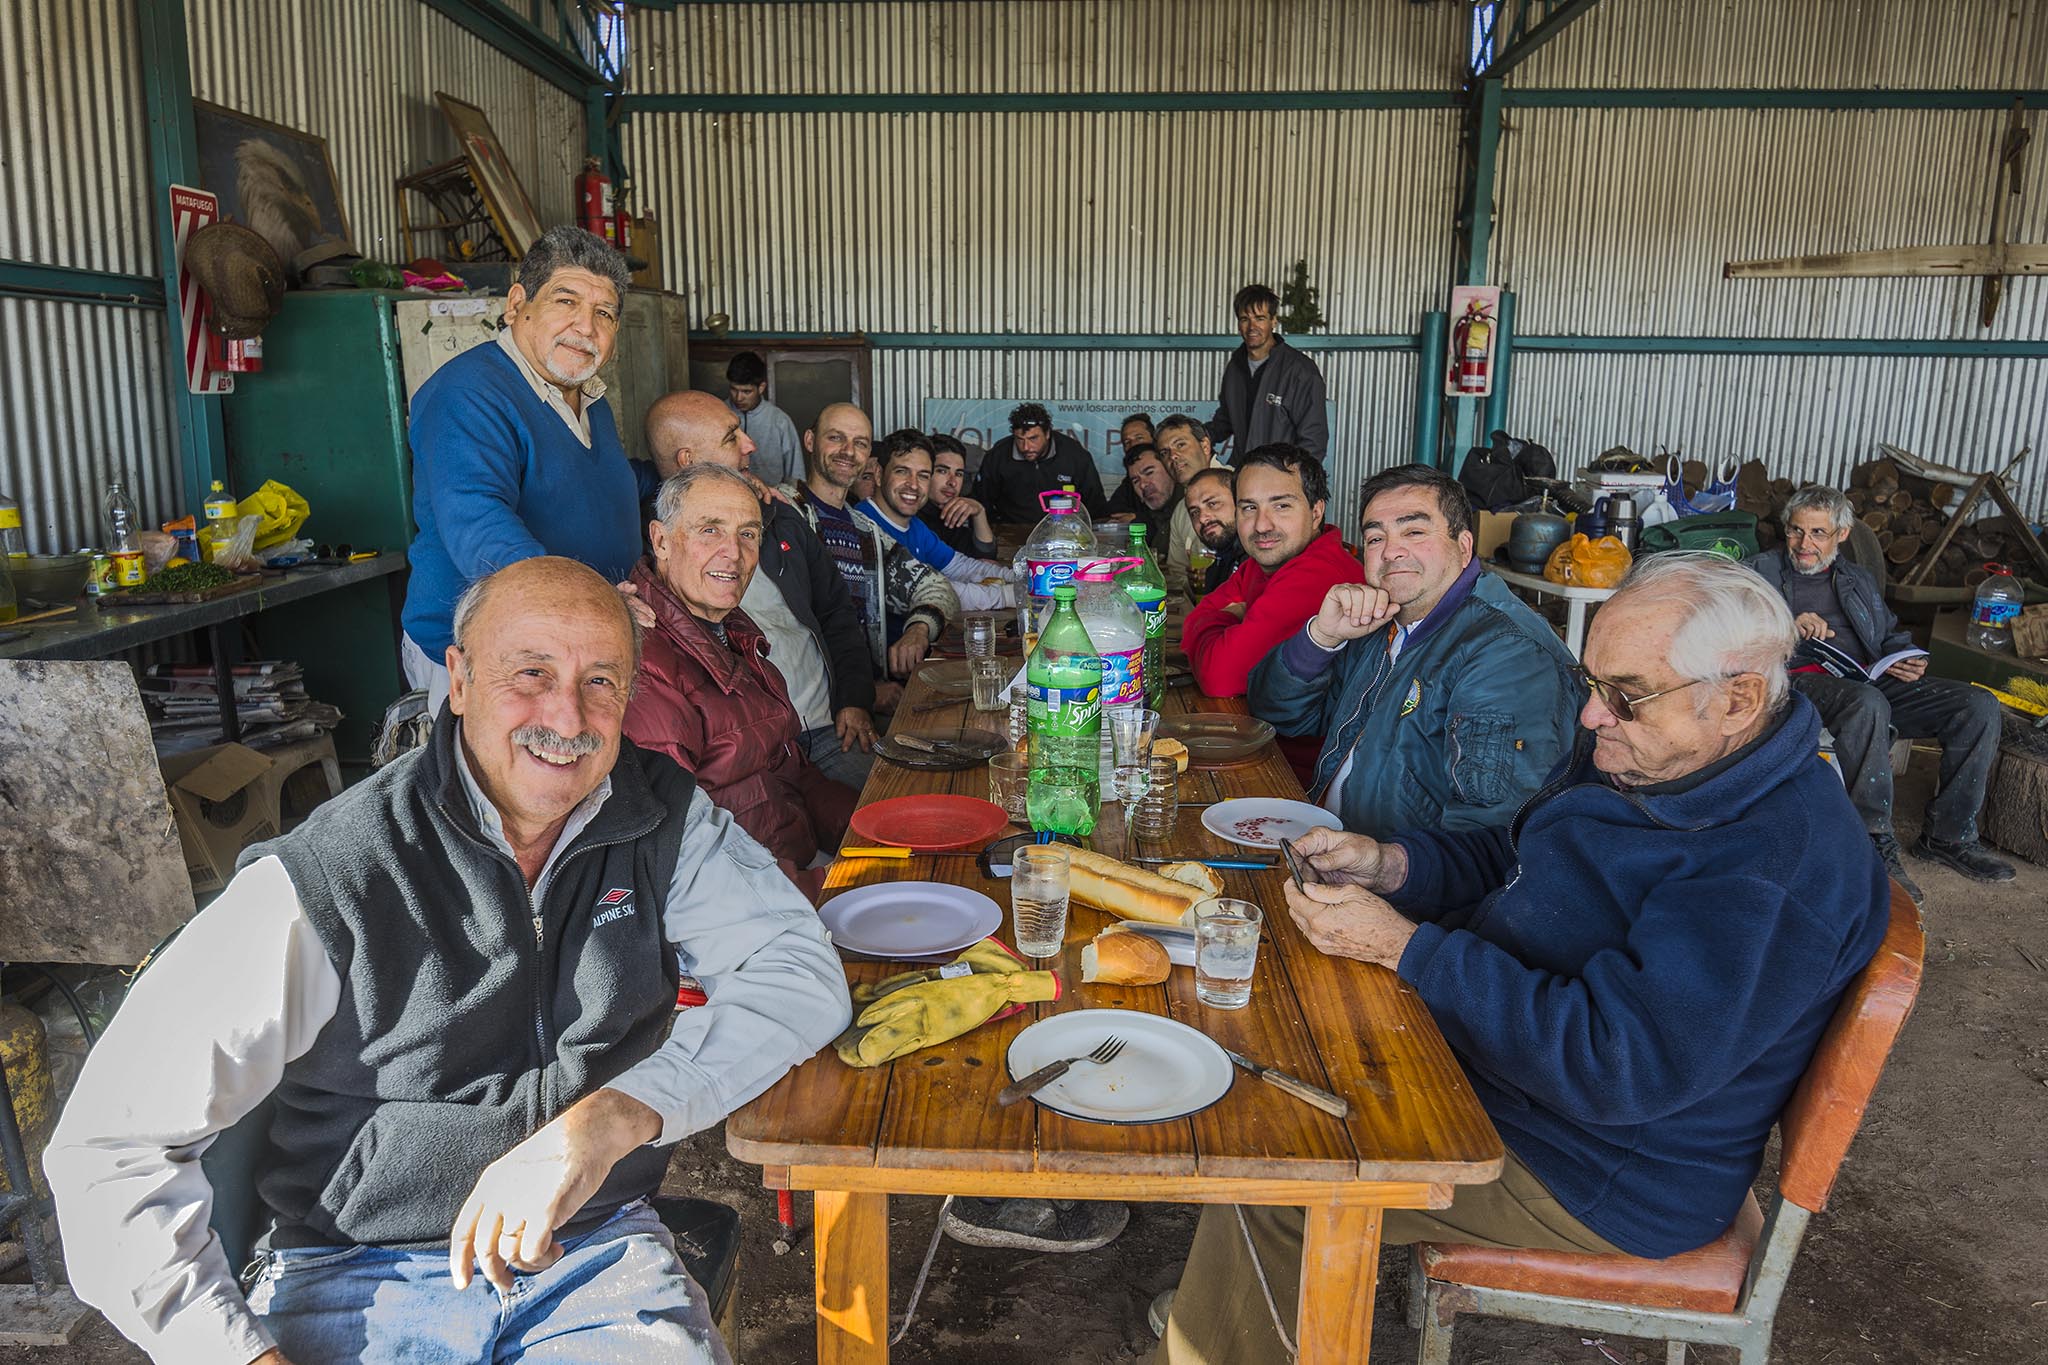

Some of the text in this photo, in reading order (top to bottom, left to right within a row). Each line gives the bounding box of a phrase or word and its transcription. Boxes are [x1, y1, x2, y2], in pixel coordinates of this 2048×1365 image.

[175, 194, 214, 212] MATAFUEGO
[1058, 402, 1196, 413] www.loscaranchos.com.ar
[1146, 606, 1167, 630] Spri
[1069, 694, 1101, 726] Sprit
[593, 907, 623, 928] ALPINE
